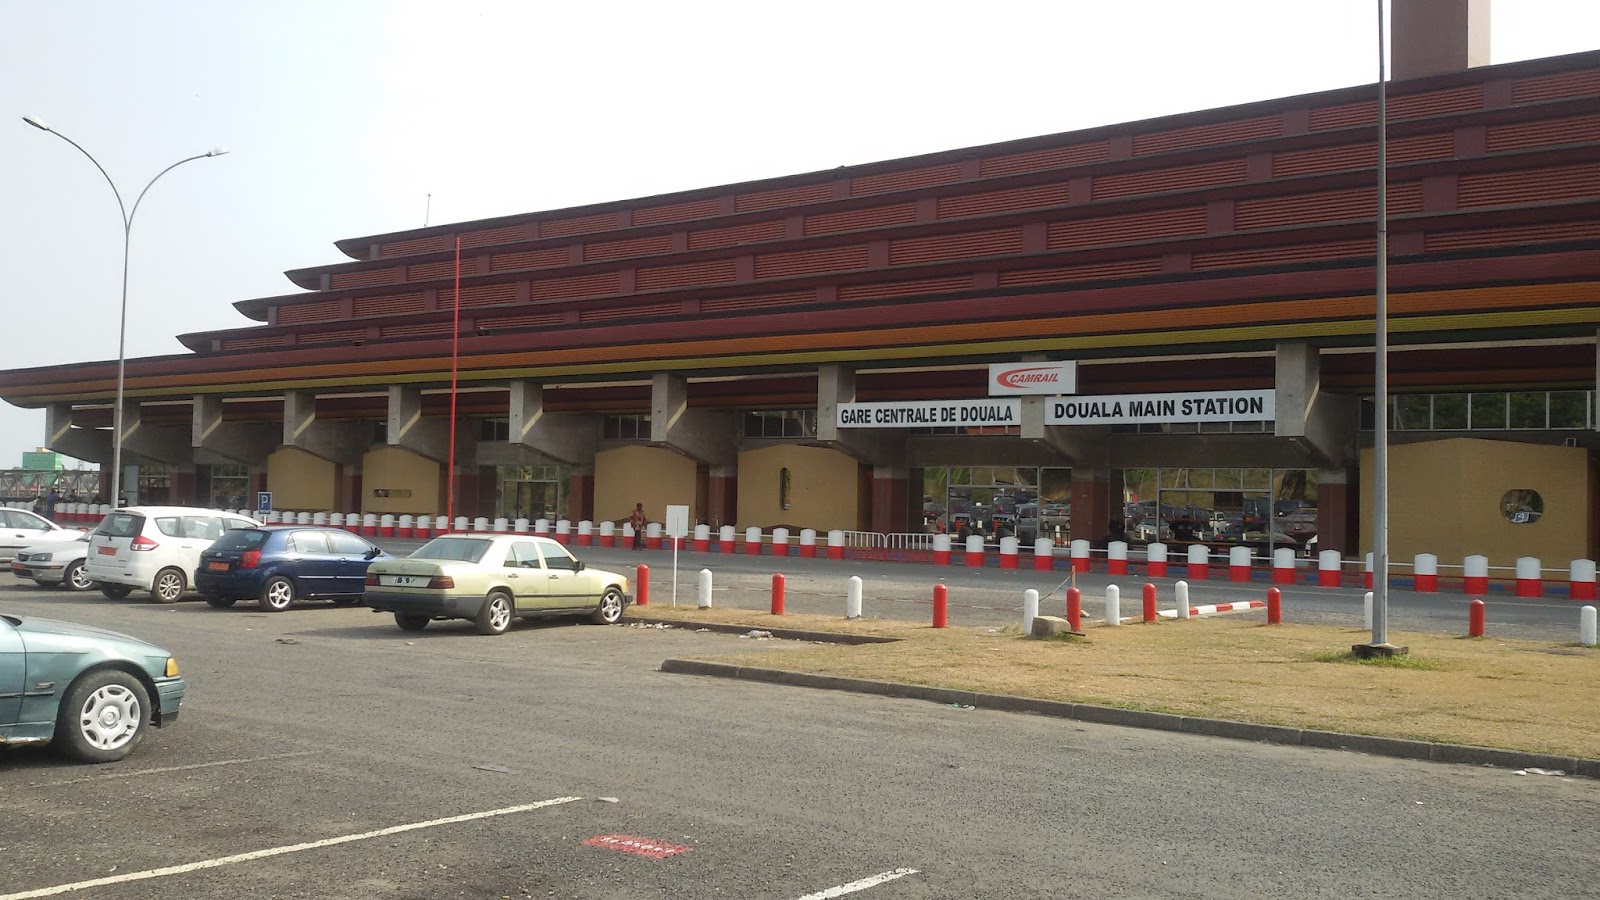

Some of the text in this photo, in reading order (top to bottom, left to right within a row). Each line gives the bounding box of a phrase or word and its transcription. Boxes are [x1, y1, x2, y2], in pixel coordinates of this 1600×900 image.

[1010, 373, 1059, 383] CAMRAIL
[841, 405, 1013, 424] GARE CENTRALE DE DOUALA
[1054, 396, 1263, 419] DOUALA MAIN STATION
[261, 494, 269, 509] P
